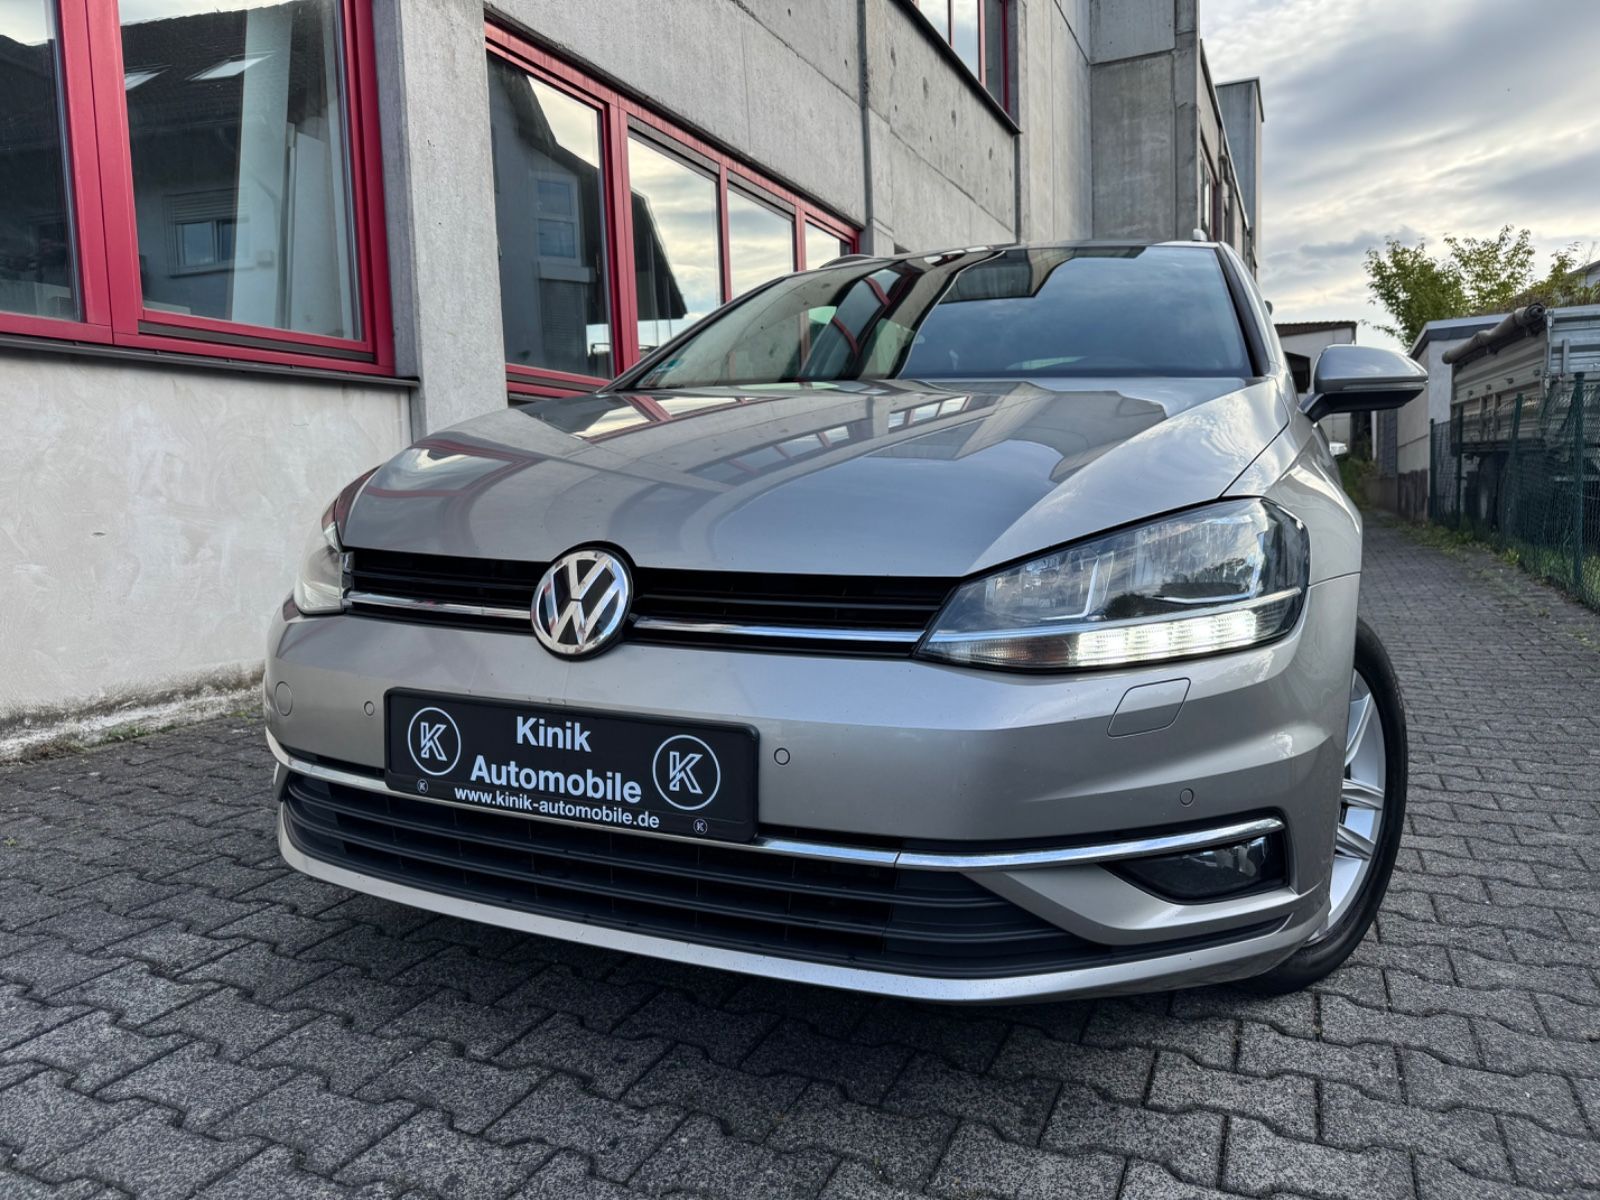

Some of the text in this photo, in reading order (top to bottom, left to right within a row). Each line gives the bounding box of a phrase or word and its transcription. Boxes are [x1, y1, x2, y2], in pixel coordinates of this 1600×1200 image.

[420, 722, 447, 761] K
[516, 716, 591, 752] Kinik
[470, 755, 642, 804] Automobile
[669, 751, 703, 794] K
[454, 786, 660, 828] www.kinik-automobile.de
